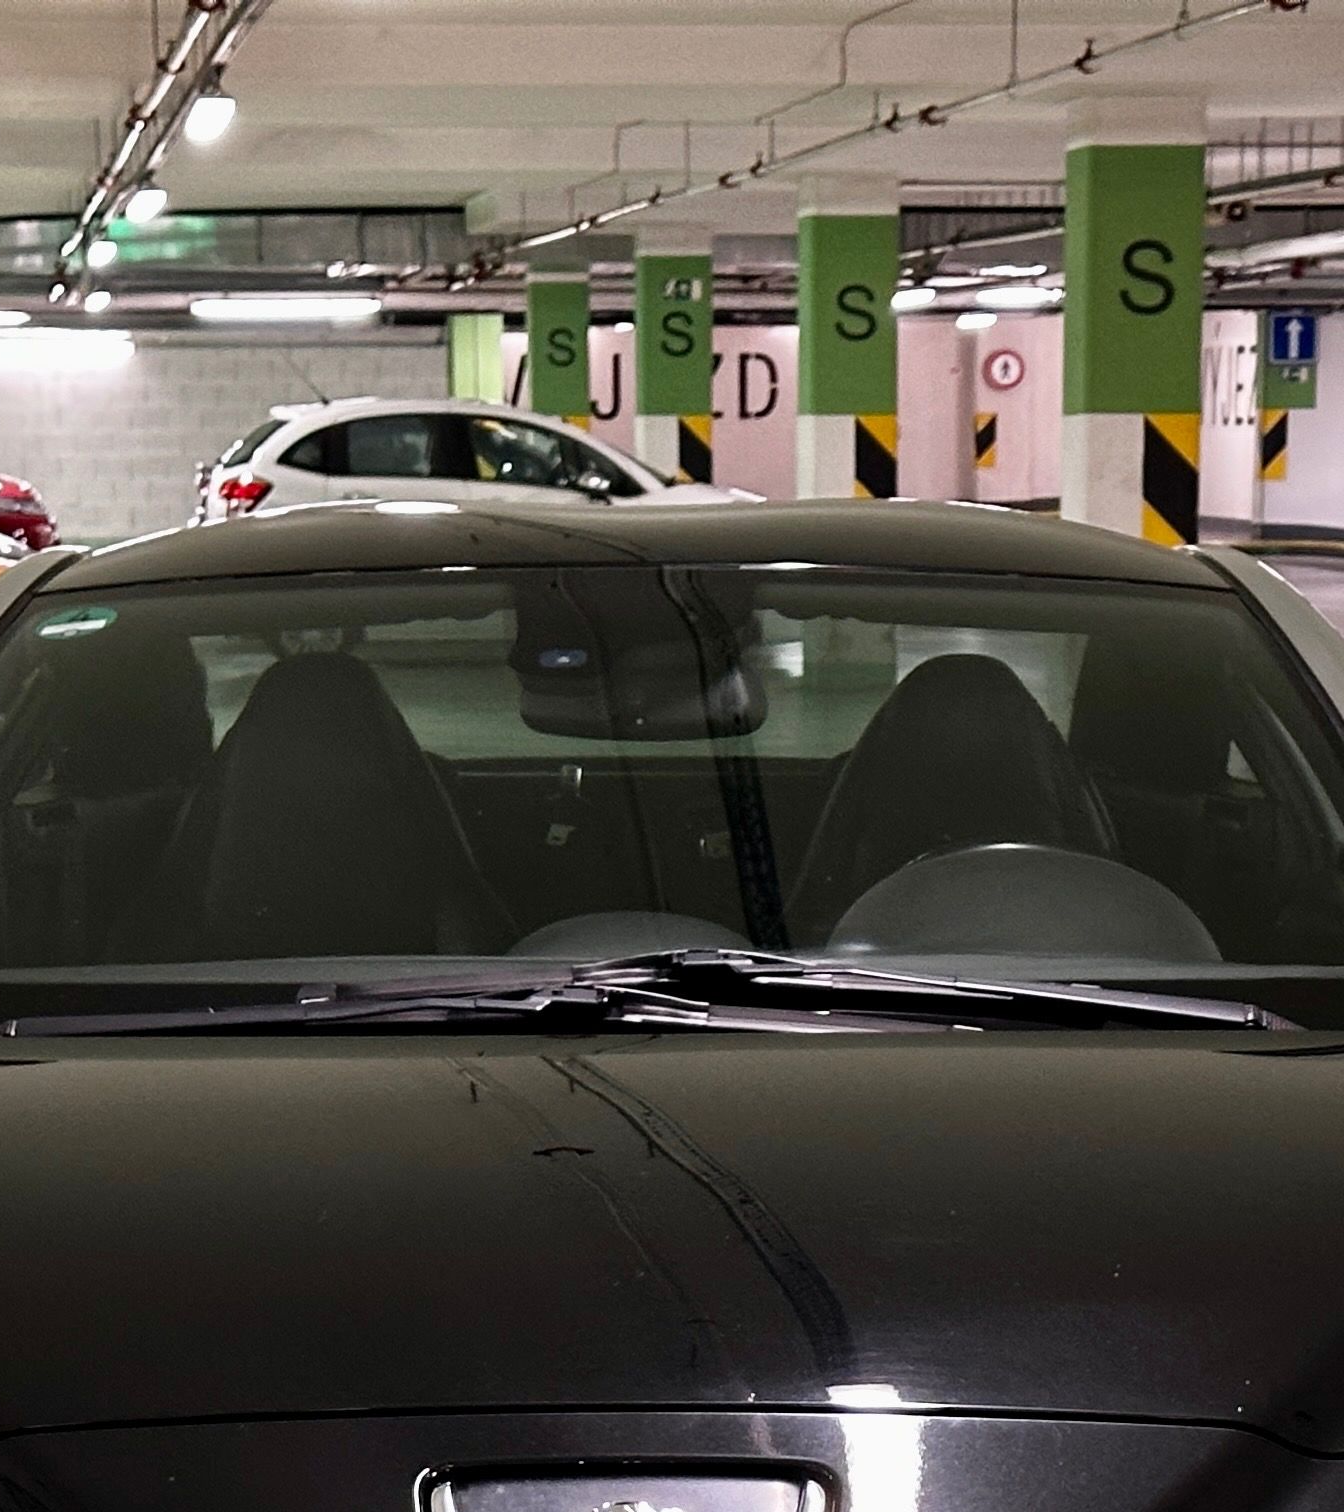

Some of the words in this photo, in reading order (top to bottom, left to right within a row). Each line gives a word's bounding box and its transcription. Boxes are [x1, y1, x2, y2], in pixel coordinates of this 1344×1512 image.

[1119, 240, 1176, 316] S
[660, 310, 695, 358] S
[834, 284, 878, 342] S
[546, 327, 576, 368] S
